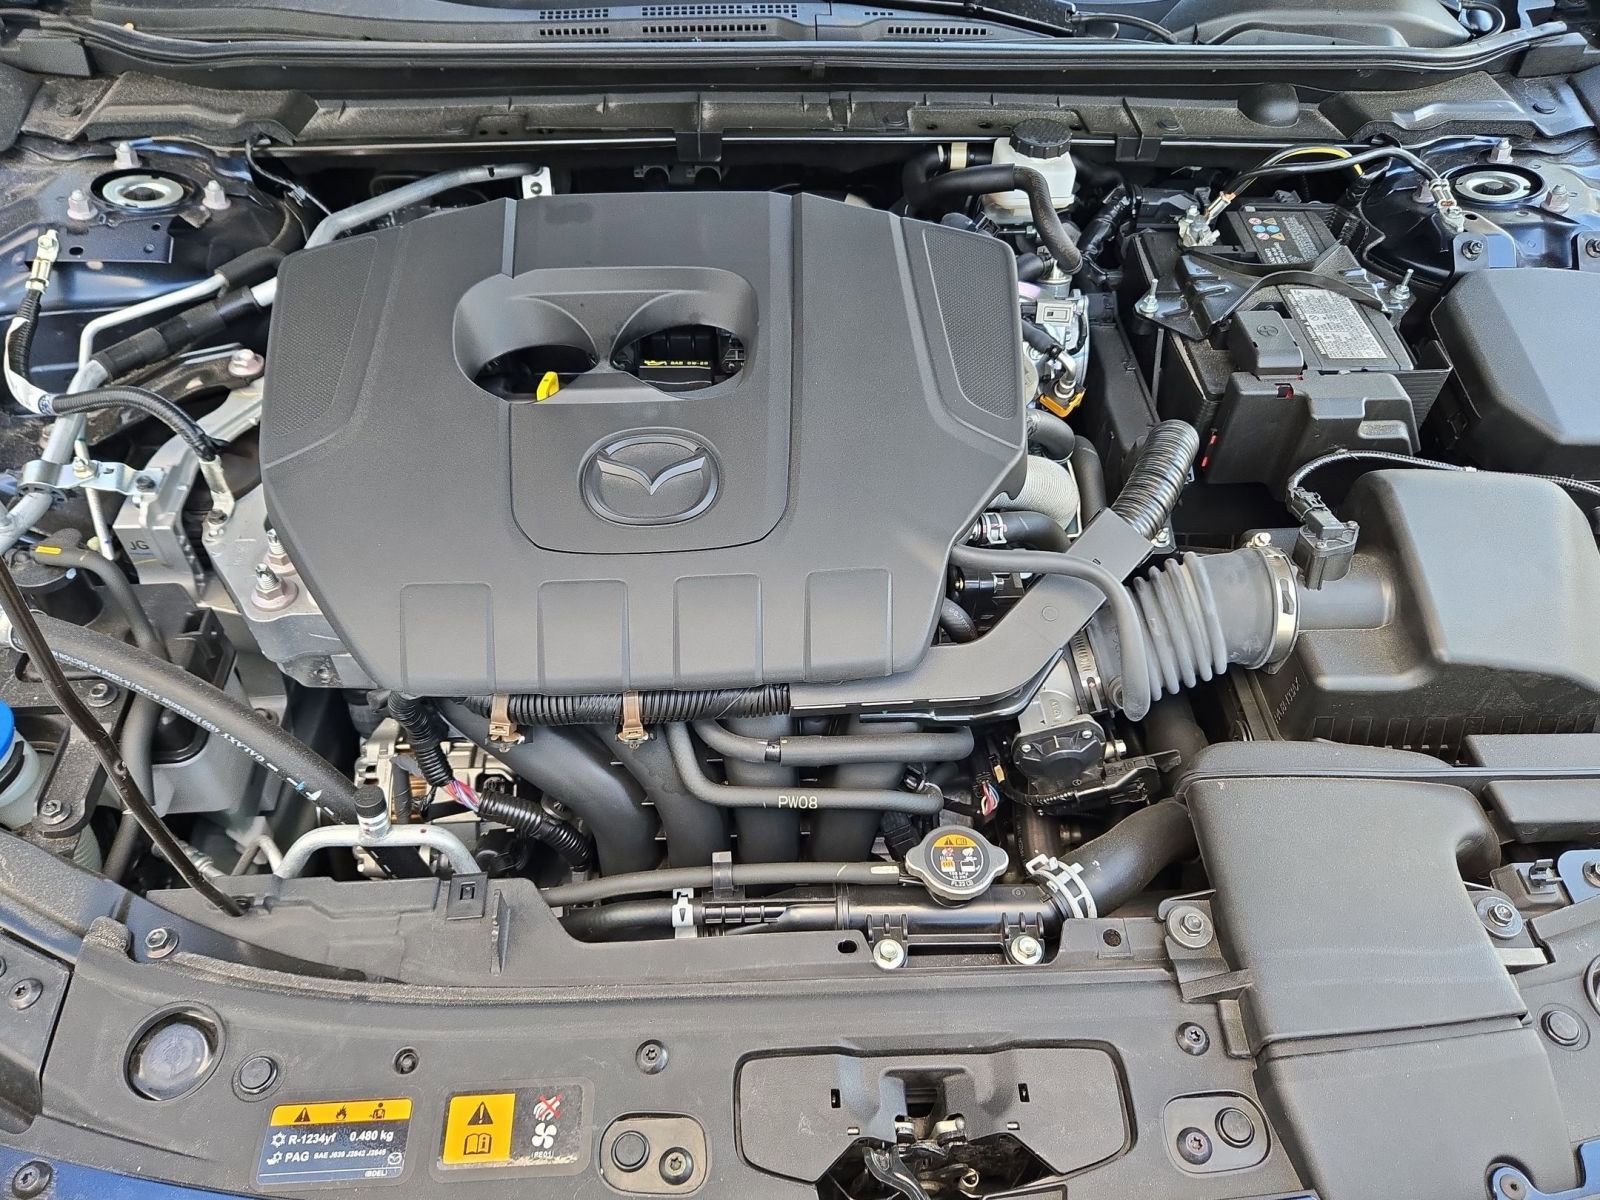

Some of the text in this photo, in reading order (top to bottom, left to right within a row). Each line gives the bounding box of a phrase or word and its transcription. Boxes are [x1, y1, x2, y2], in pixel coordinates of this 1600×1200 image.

[220, 732, 266, 762] GALAXY
[778, 795, 818, 809] PW08
[288, 1130, 395, 1146] R-1234yf 0.480 kg
[285, 1152, 309, 1163] PAG
